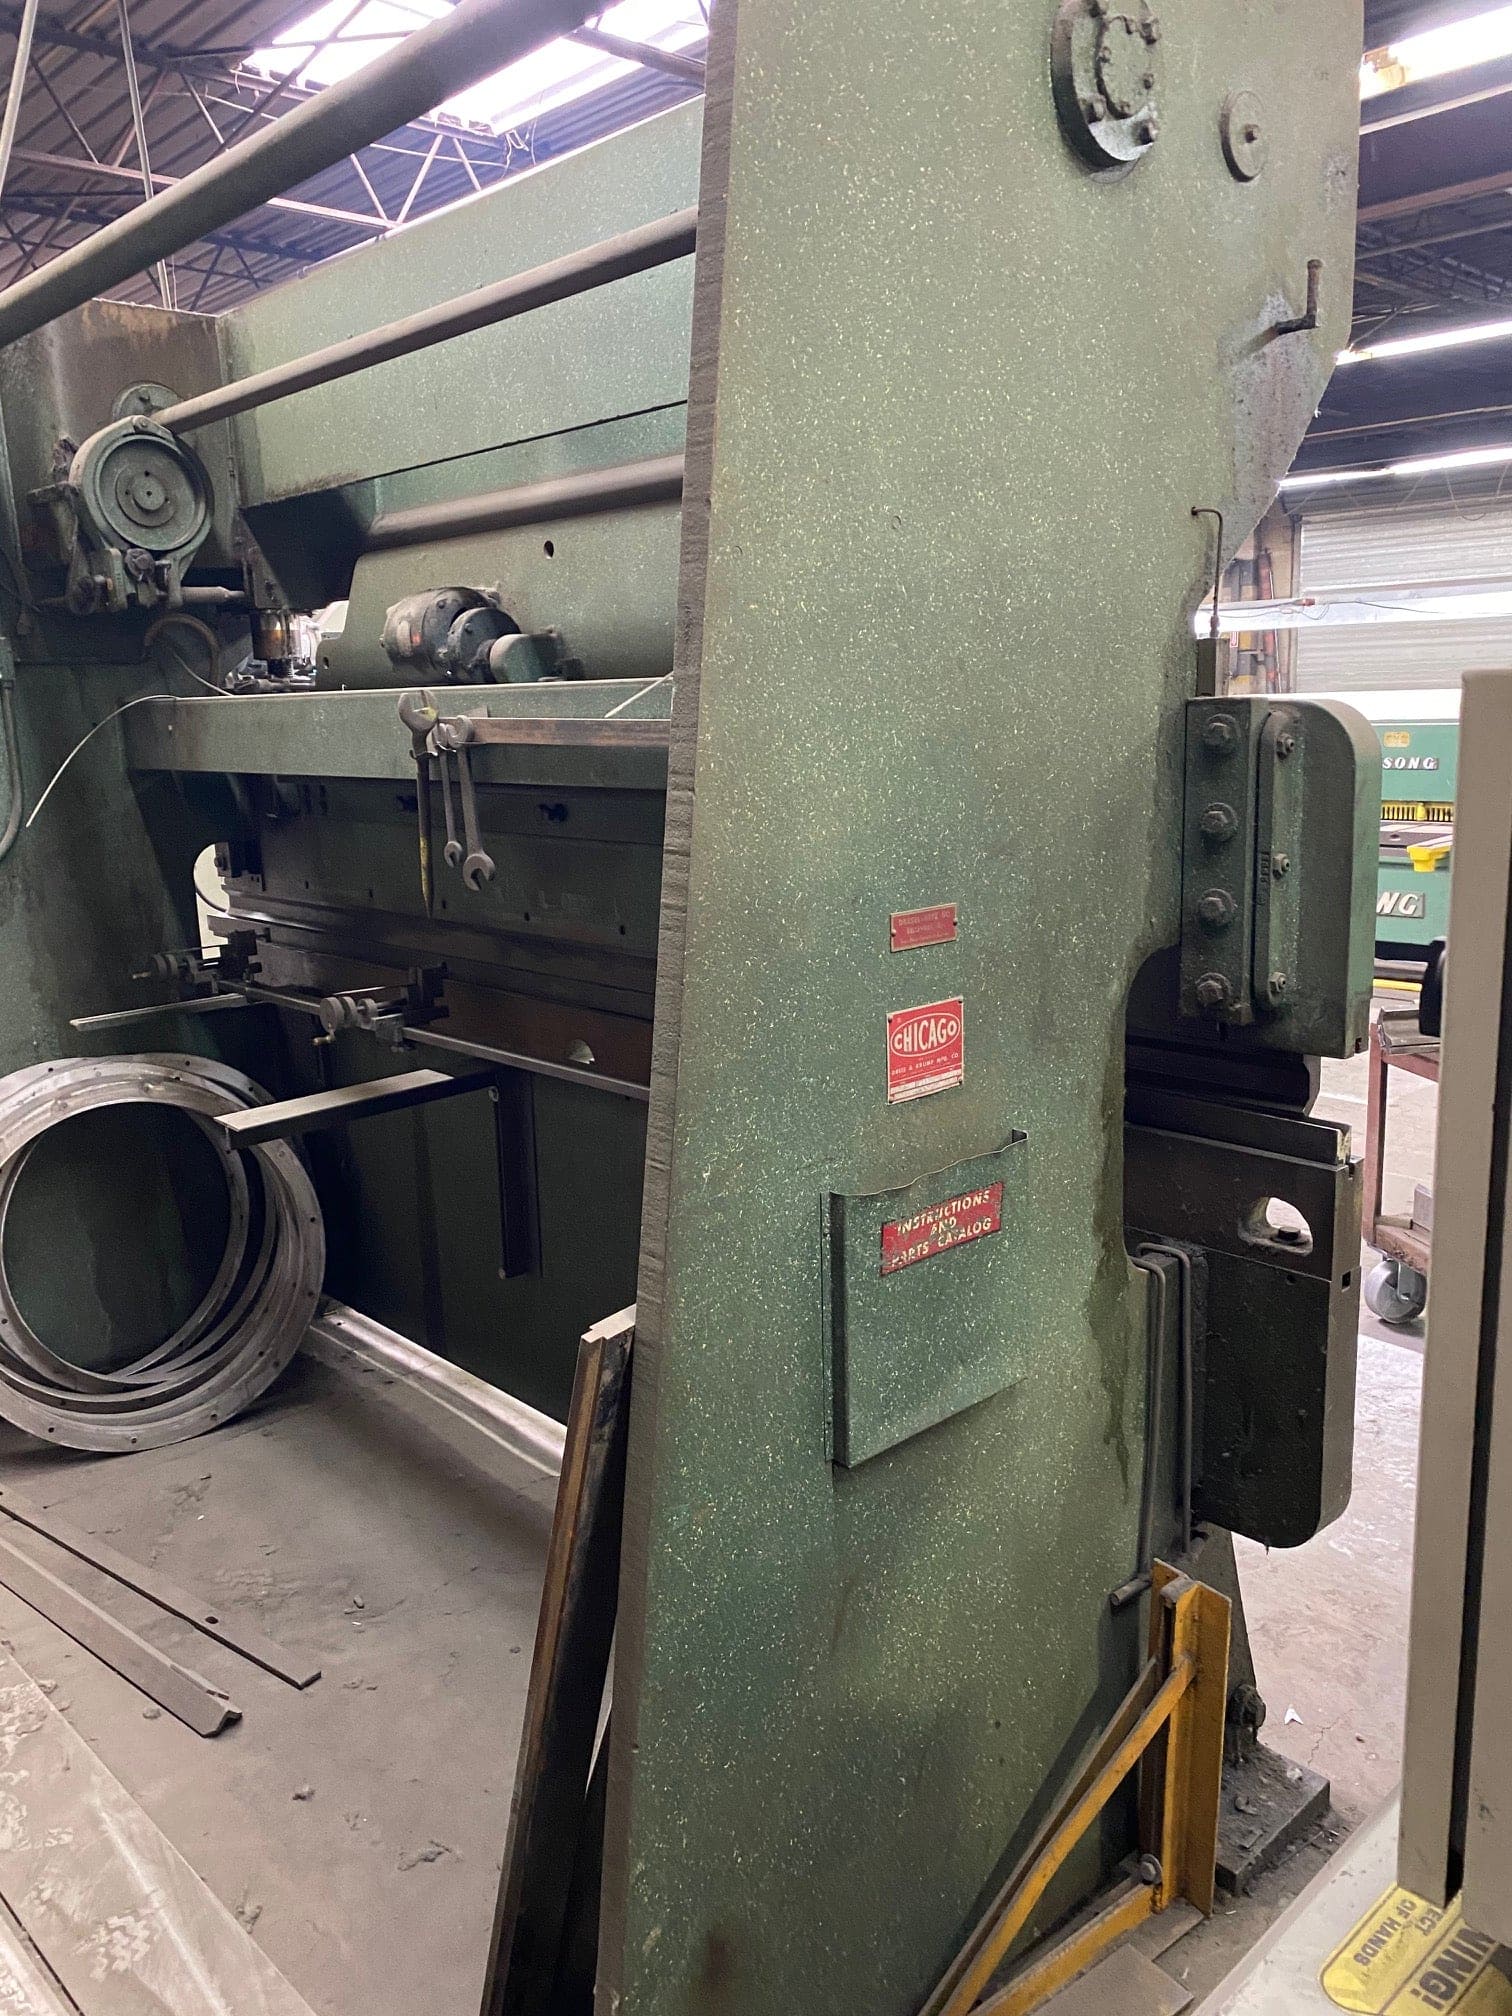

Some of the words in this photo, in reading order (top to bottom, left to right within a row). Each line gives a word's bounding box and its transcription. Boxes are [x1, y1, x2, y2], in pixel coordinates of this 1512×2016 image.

[1382, 757, 1437, 769] SONG
[1376, 891, 1418, 915] NG
[894, 1018, 958, 1053] CHICAGO
[938, 1217, 992, 1247] CAALOG
[1396, 1898, 1418, 1920] OF
[1353, 1916, 1402, 1967] HANDS
